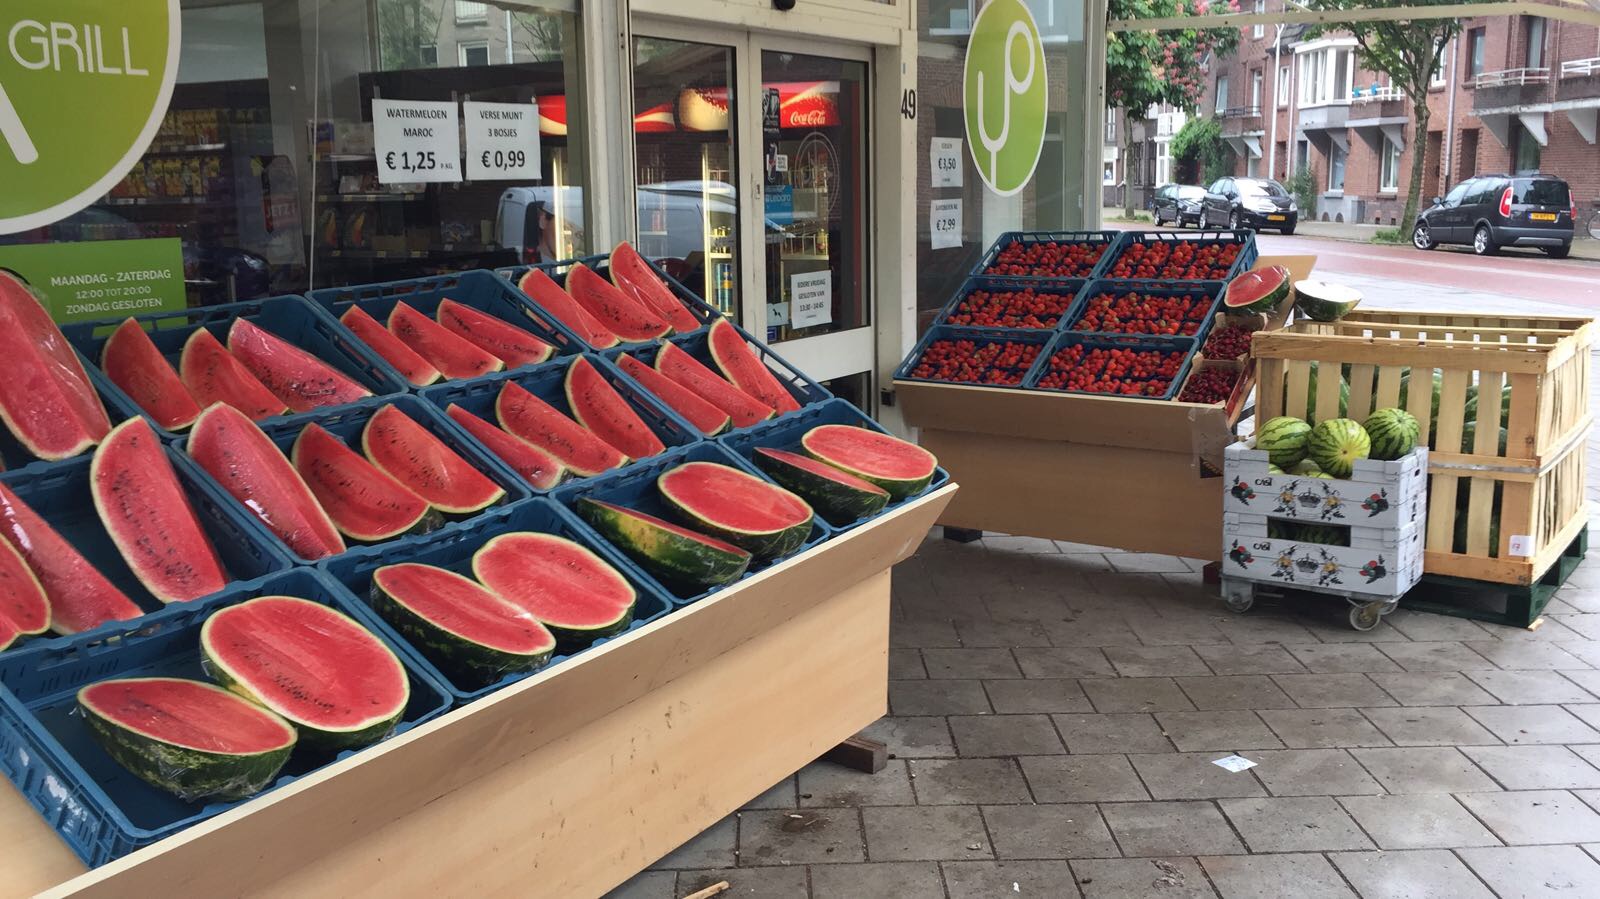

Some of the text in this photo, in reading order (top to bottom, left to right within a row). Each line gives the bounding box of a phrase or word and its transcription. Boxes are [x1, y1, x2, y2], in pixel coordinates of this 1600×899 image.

[8, 19, 149, 77] GRILL
[901, 89, 916, 120] 49
[386, 108, 448, 120] WATERMELOEN
[479, 110, 523, 121] VERSE MUNT
[403, 127, 434, 138] MAROC
[487, 128, 518, 138] 3 BOSJES
[401, 151, 436, 173] 1,25
[494, 150, 526, 171] 0,99
[51, 273, 108, 287] MAANDAG
[116, 269, 172, 283] ZATERDAG
[76, 286, 152, 300] 12:00 TOT 20:00
[65, 298, 163, 315] ZONDAG GESLOTEN
